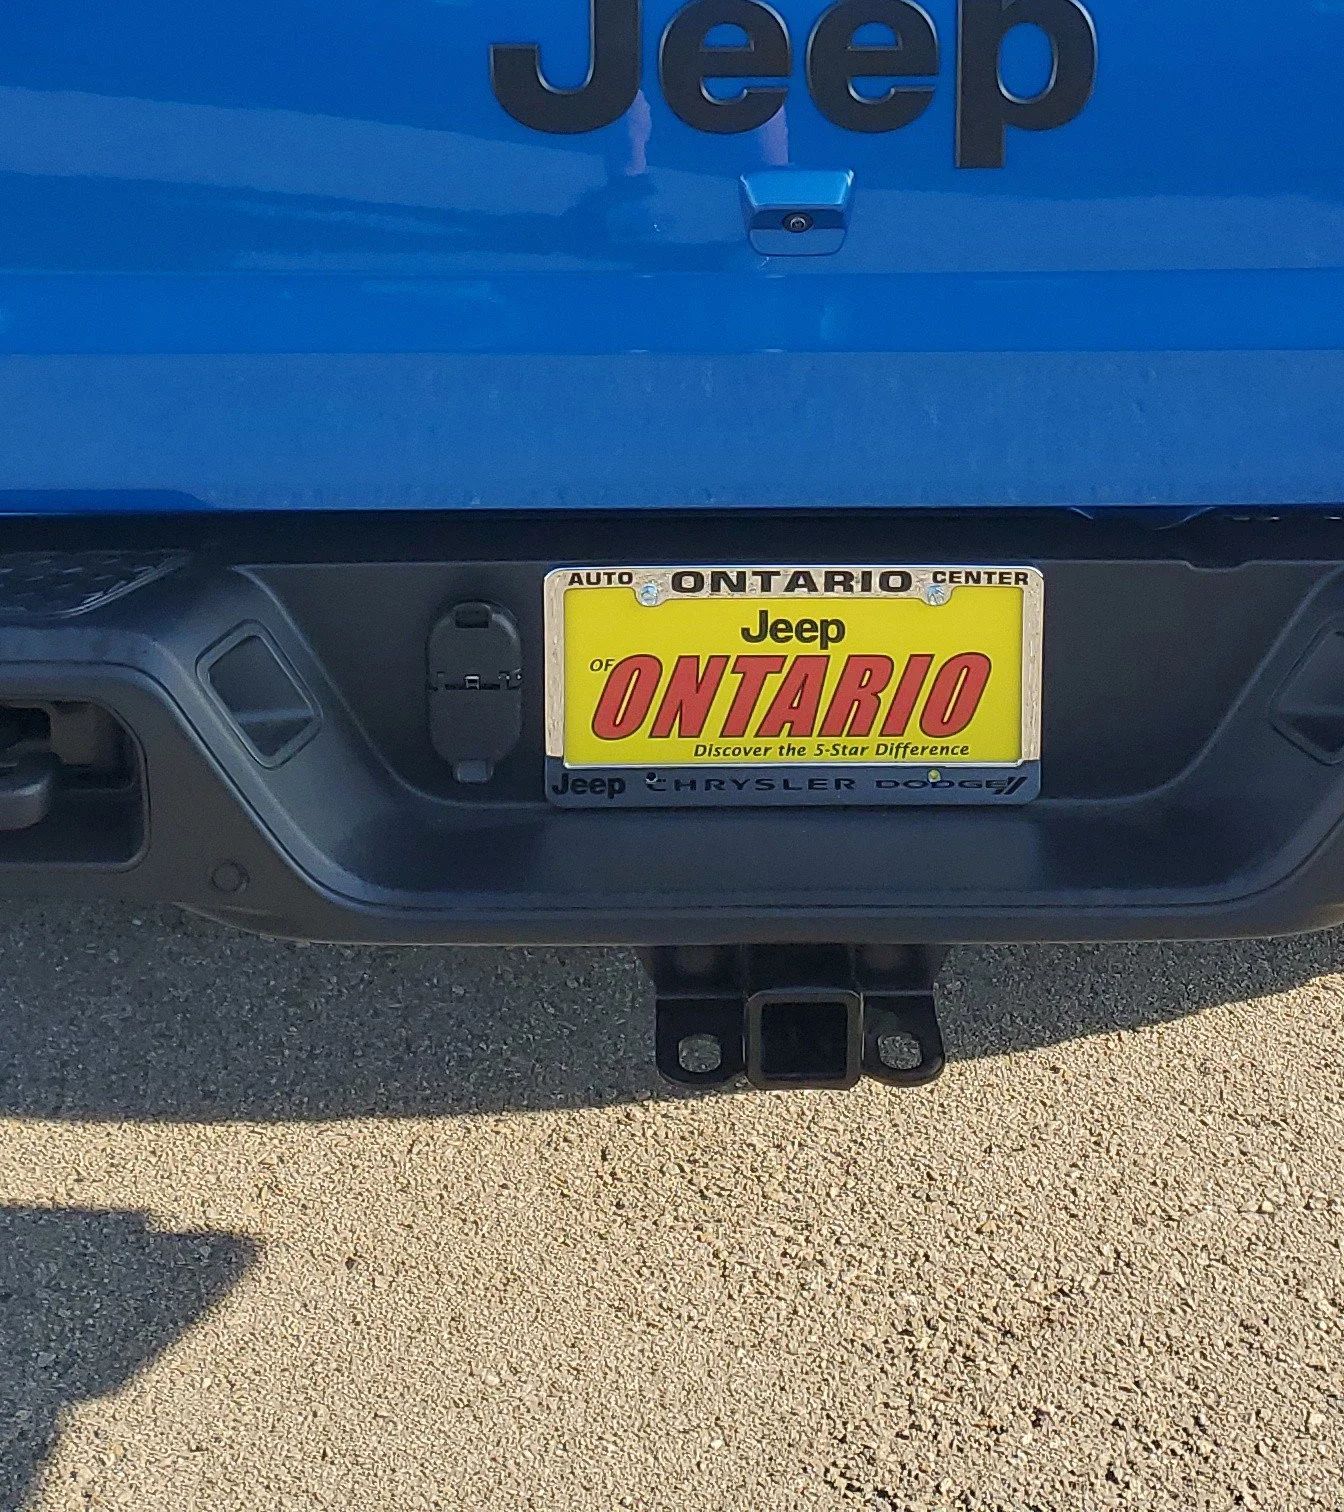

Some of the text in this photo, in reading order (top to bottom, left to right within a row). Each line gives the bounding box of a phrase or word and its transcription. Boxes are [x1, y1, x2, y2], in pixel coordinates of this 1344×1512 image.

[568, 570, 1029, 594] AUTO ONTARIO CENTER
[740, 609, 846, 651] Jeep
[589, 658, 616, 672] OF
[591, 651, 992, 741] ONTARIO
[693, 741, 970, 760] Discover the 5-Star Difference
[551, 772, 1008, 800] Jeep CHRYSLER DODGE
